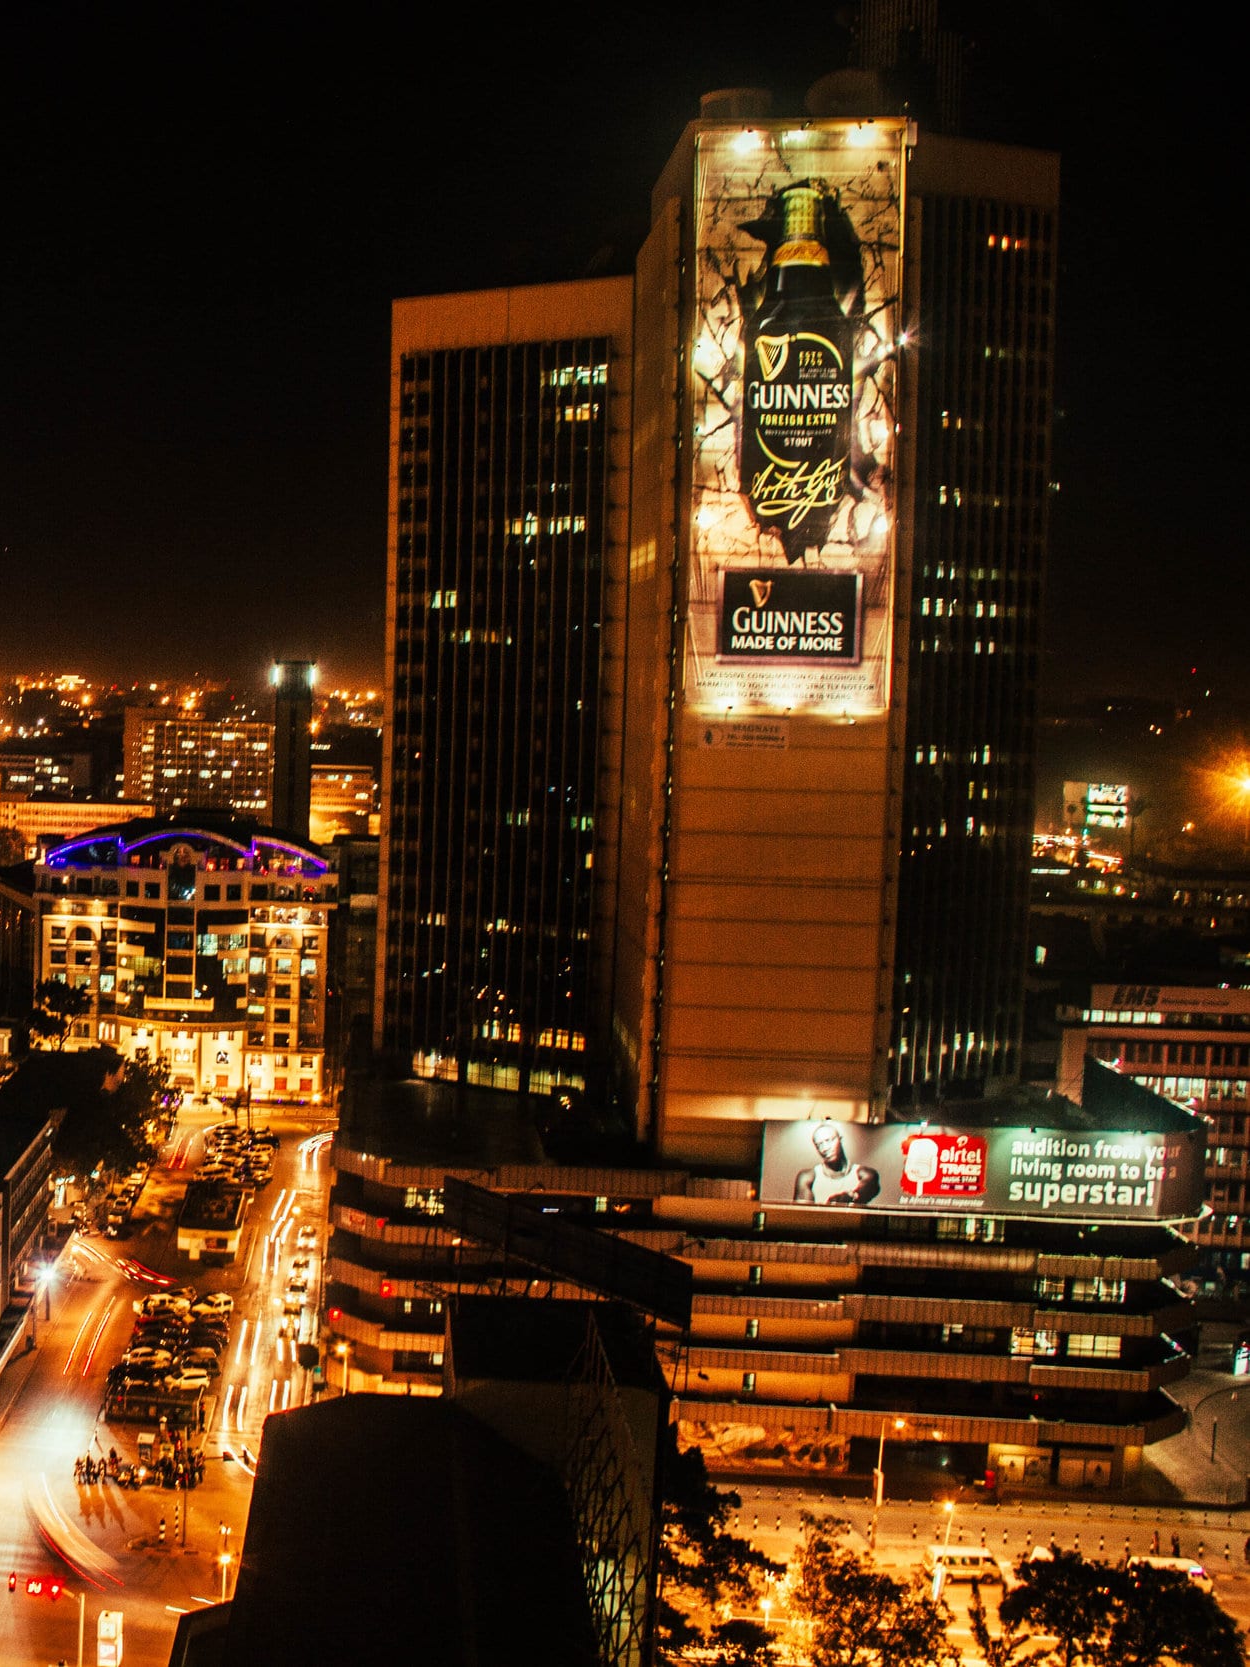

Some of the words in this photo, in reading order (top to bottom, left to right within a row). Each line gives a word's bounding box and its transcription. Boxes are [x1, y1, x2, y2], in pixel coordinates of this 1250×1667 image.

[749, 381, 850, 410] GUINNESS
[760, 413, 804, 426] FOREIGN
[806, 413, 837, 426] EXTRA
[784, 437, 814, 447] STOUT
[732, 606, 843, 635] GUINNESS
[731, 636, 774, 650] MADE
[776, 636, 797, 650] OF
[799, 637, 843, 651] MORE
[940, 1146, 982, 1164] airtel
[1011, 1137, 1090, 1158] audition
[1094, 1140, 1142, 1159] from
[1144, 1145, 1181, 1163] your
[939, 1163, 982, 1176] TRACE
[1010, 1157, 1063, 1181] living
[1067, 1164, 1116, 1179] room
[1120, 1163, 1140, 1180] to
[1144, 1163, 1166, 1181] be
[1168, 1166, 1177, 1179] a
[909, 1196, 935, 1206] Africa's
[935, 1198, 952, 1206] next
[952, 1198, 984, 1208] superstar
[1009, 1180, 1156, 1209] superstar!
